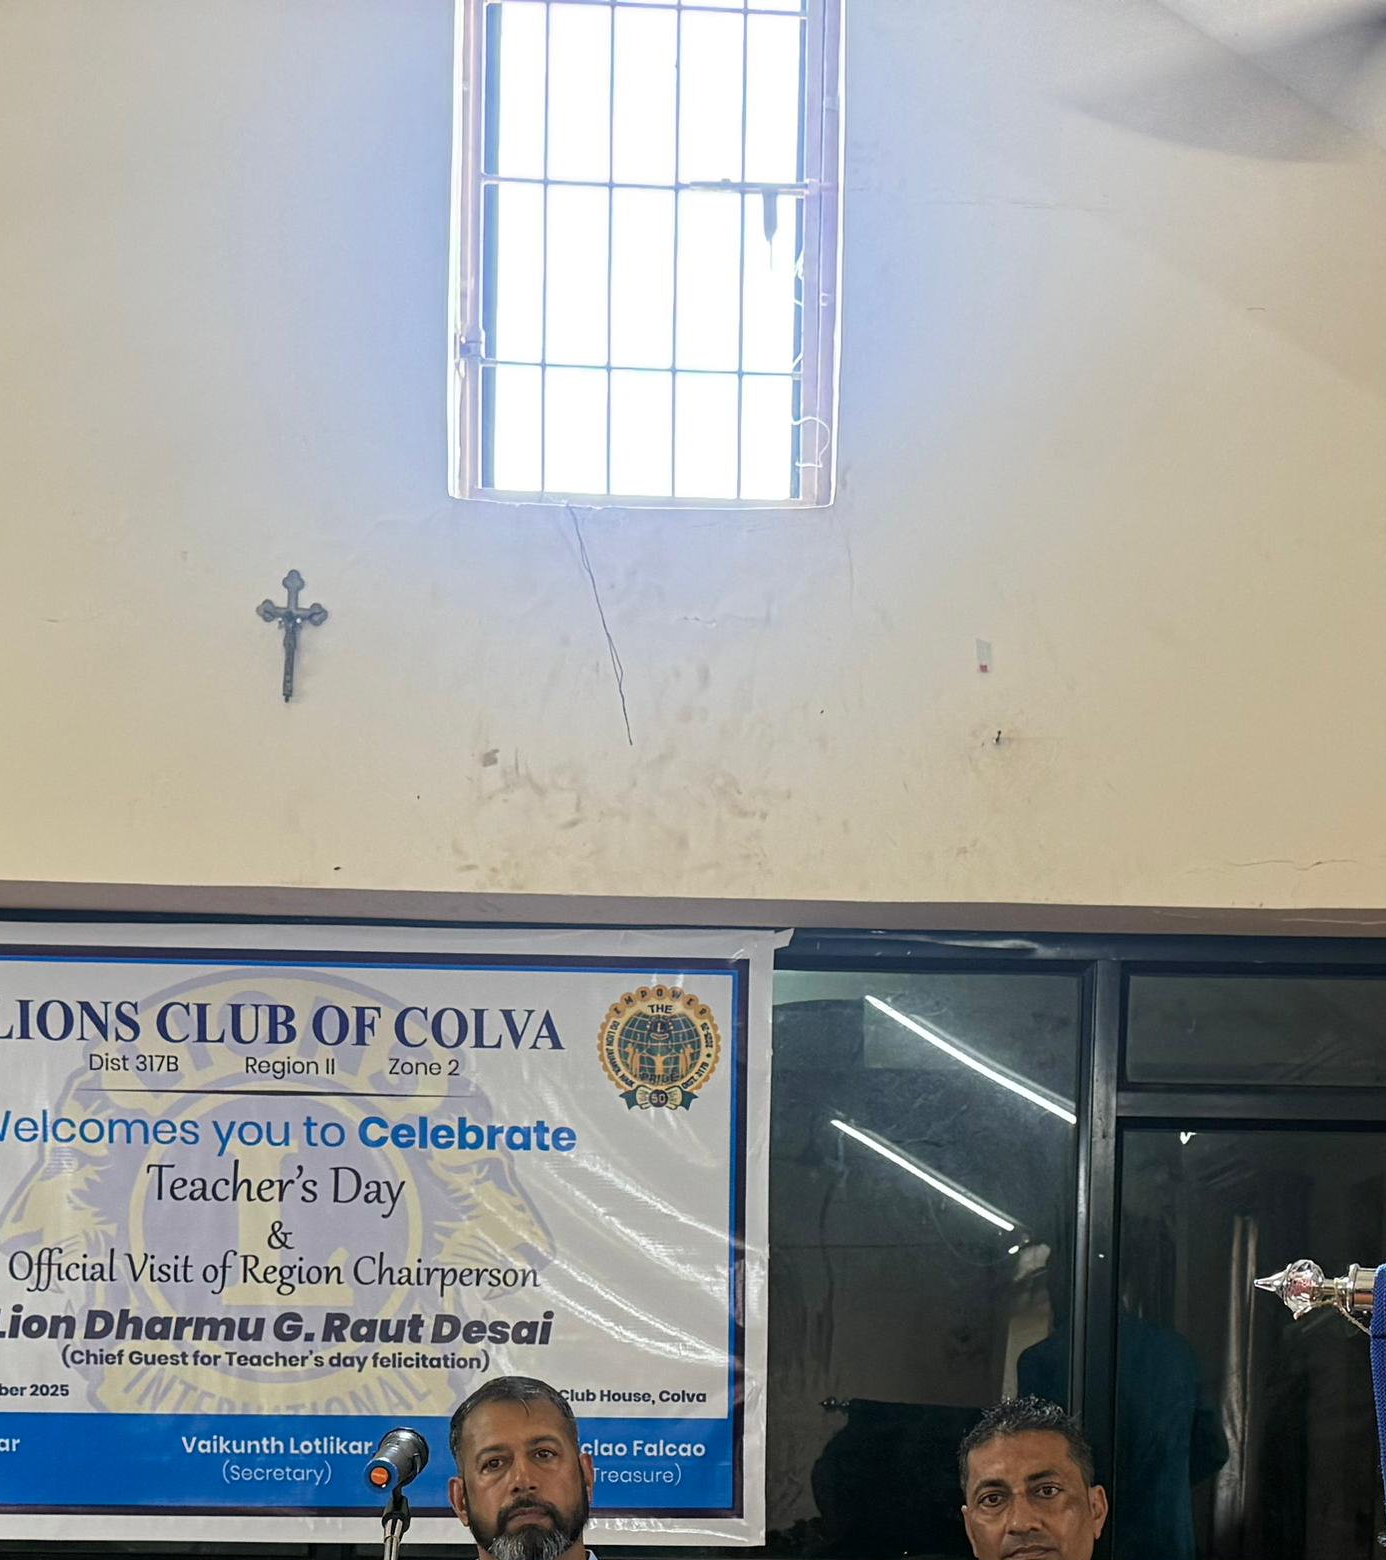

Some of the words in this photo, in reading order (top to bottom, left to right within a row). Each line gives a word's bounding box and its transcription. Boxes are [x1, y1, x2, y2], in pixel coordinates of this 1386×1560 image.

[648, 1004, 673, 1014] THE
[156, 1000, 297, 1045] CLUB
[312, 1003, 382, 1047] OF
[393, 1006, 566, 1051] COLVA
[88, 1053, 130, 1072] Dist
[135, 1054, 179, 1073] 317B
[245, 1056, 319, 1081] Region
[326, 1058, 335, 1075] II
[389, 1058, 441, 1076] Zone
[448, 1059, 460, 1076] 2
[651, 1093, 666, 1104] 50
[214, 1118, 290, 1156] you
[303, 1115, 346, 1148] to
[358, 1116, 578, 1153] Celebrate
[333, 1166, 405, 1219] Day
[266, 1221, 294, 1251] &
[8, 1247, 117, 1292] Official
[124, 1250, 193, 1285] Visit
[202, 1250, 238, 1295] of
[241, 1253, 342, 1296] Region
[353, 1252, 542, 1298] Chairperson
[84, 1308, 265, 1343] Dharmu
[273, 1312, 314, 1344] G.
[322, 1312, 424, 1345] Raut
[431, 1310, 555, 1346] Desai
[60, 1344, 124, 1369] (Chief
[127, 1348, 189, 1368] Guest
[192, 1348, 222, 1367] for
[328, 1350, 369, 1374] day
[371, 1348, 491, 1373] felicitation)
[29, 1383, 70, 1397] 2025
[560, 1389, 596, 1402] Club
[599, 1389, 655, 1405] House,
[659, 1390, 707, 1403] Colva
[181, 1435, 285, 1455] Vaikunth
[289, 1435, 373, 1456] Lotlikar
[633, 1440, 706, 1457] Falcao
[222, 1461, 333, 1485] (Secretary)
